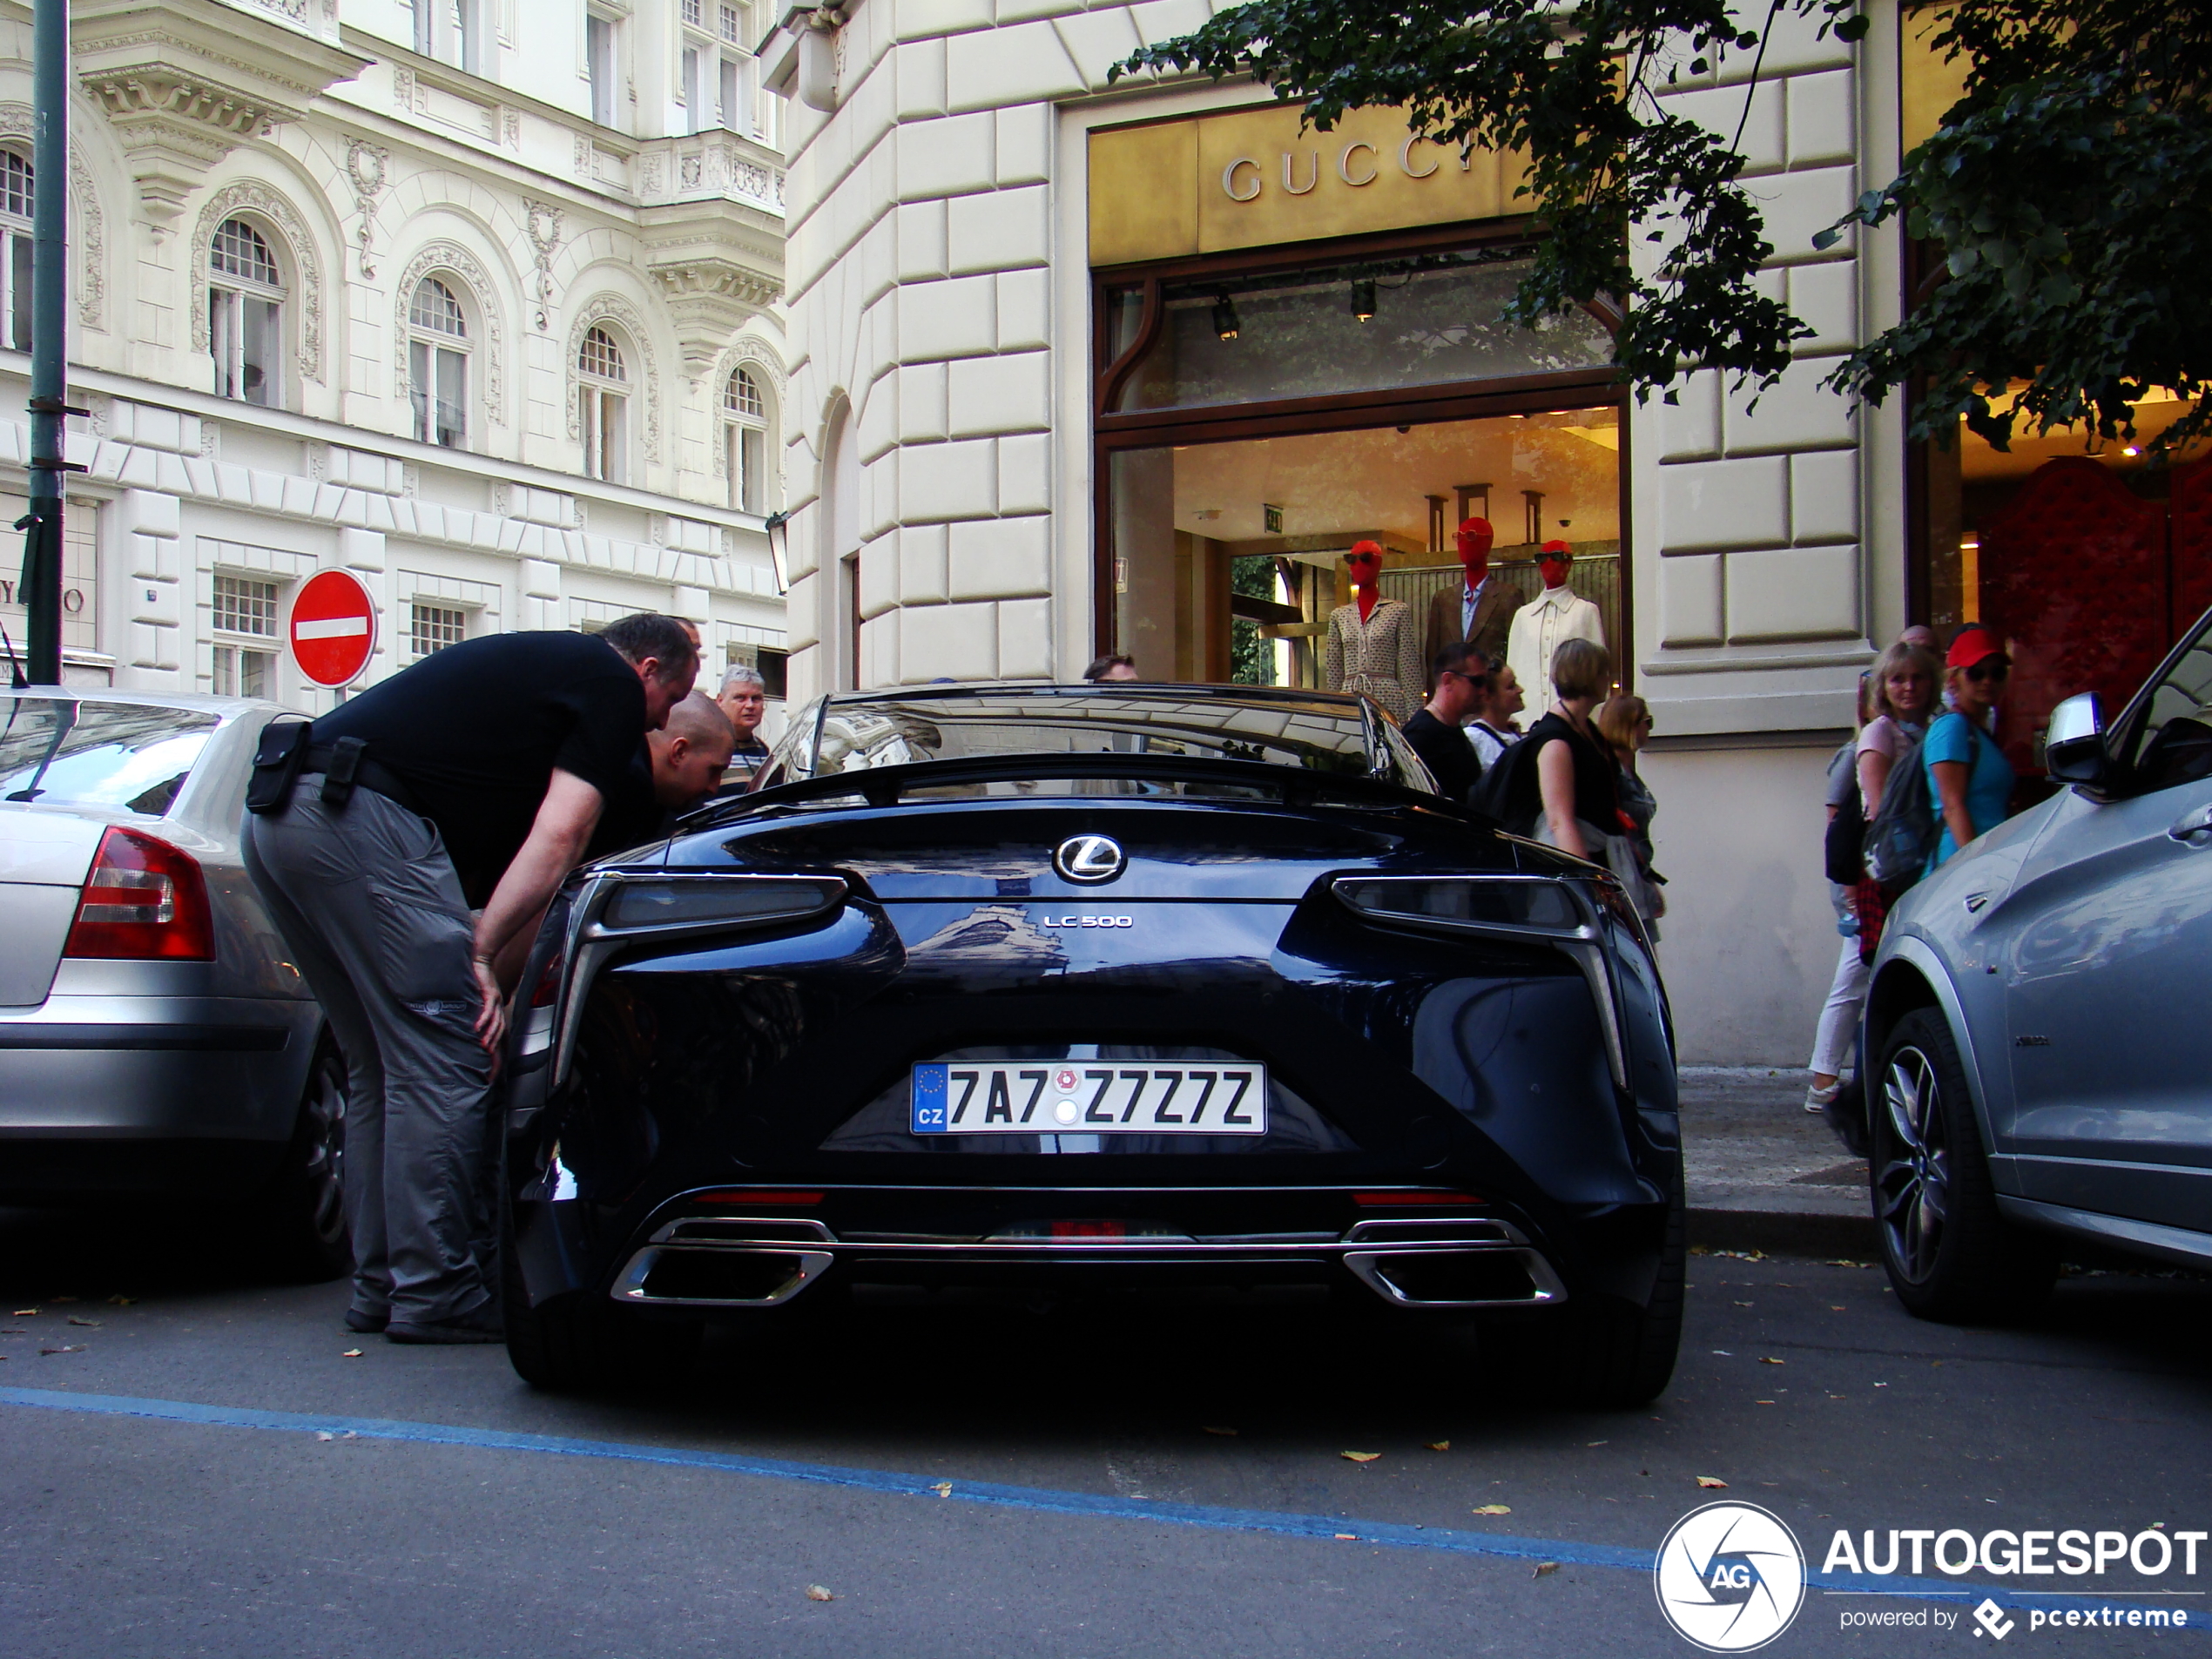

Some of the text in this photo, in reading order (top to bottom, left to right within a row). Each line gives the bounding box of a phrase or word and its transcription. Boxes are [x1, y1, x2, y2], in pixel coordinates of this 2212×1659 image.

[1044, 915, 1133, 928] LC 500
[918, 1070, 1253, 1125] CZ 7A7 Z7Z7Z
